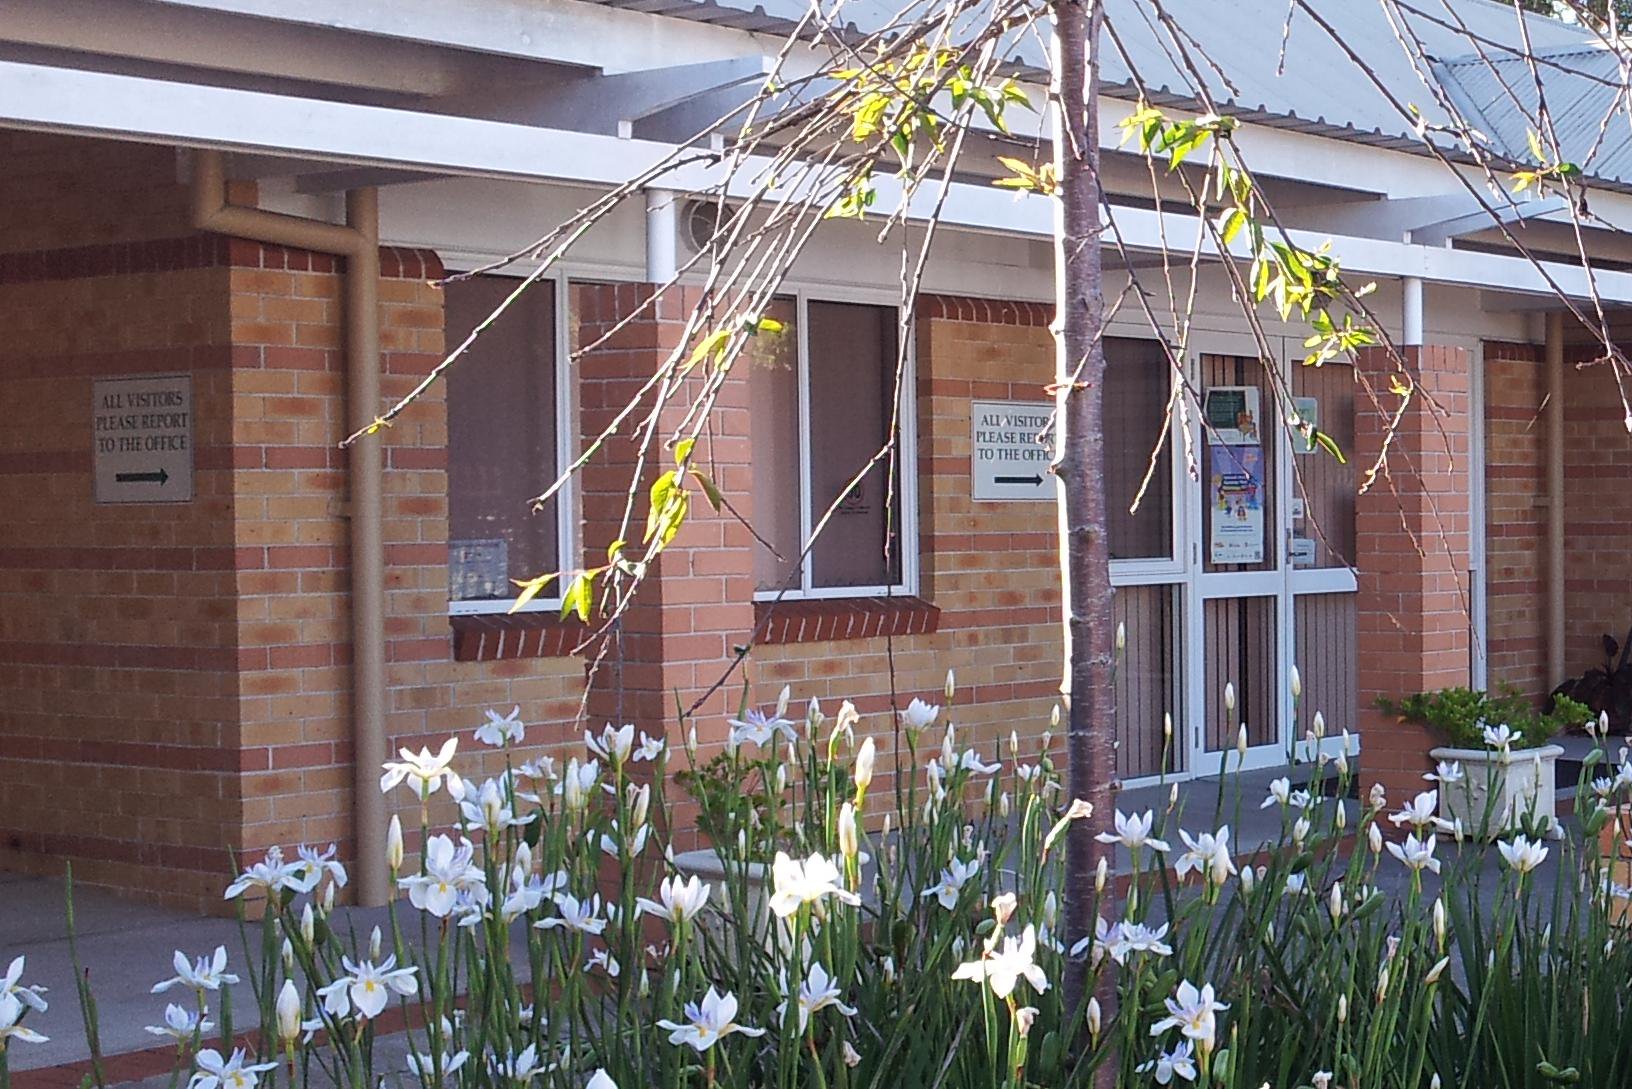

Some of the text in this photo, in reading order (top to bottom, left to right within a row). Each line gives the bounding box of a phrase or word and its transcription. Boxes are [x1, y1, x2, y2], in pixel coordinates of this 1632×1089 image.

[103, 391, 183, 409] ALL VISITORS
[96, 413, 188, 431] PLEASE REPORT
[981, 415, 1049, 428] ALL VISITOR
[98, 435, 187, 452] TO THE OFFICE
[976, 431, 1016, 444] PLEASE
[977, 448, 1055, 461] TO THE OFFIC
